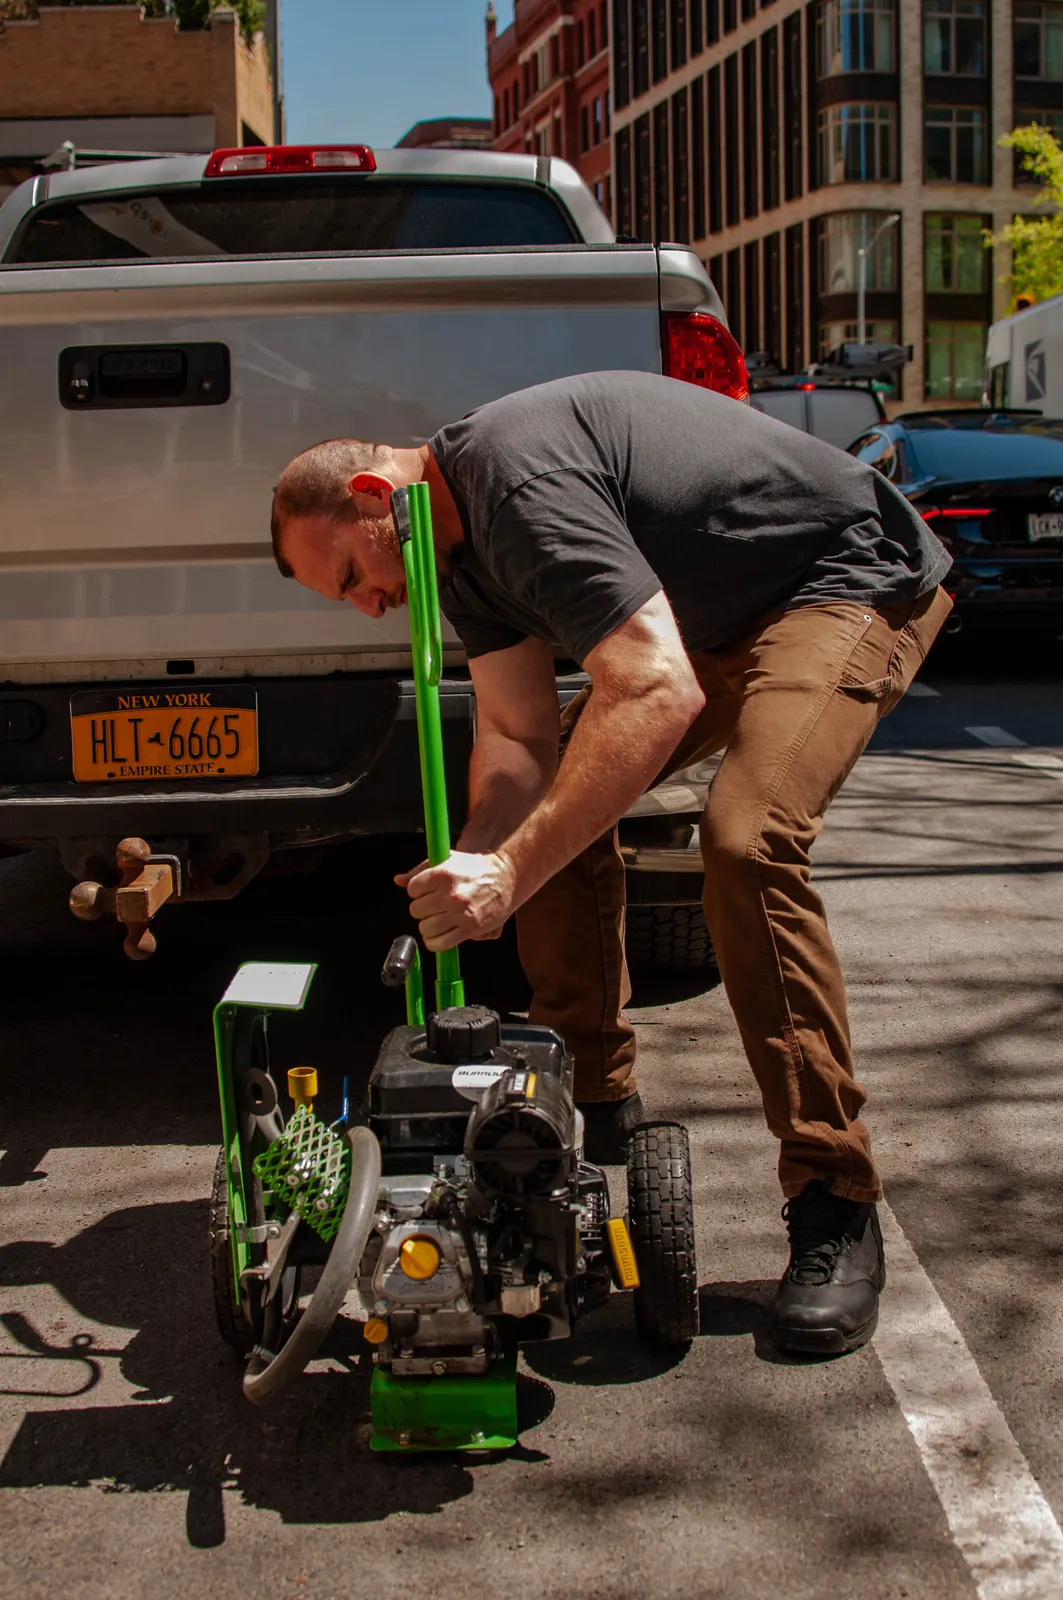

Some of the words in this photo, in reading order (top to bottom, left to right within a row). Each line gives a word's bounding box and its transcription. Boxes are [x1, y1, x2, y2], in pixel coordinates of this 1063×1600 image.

[118, 695, 160, 709] NEW
[165, 693, 211, 707] YORK
[91, 718, 143, 764] HLT
[169, 714, 239, 760] 6665
[120, 765, 170, 777] EMPIRE
[174, 763, 215, 775] STATE
